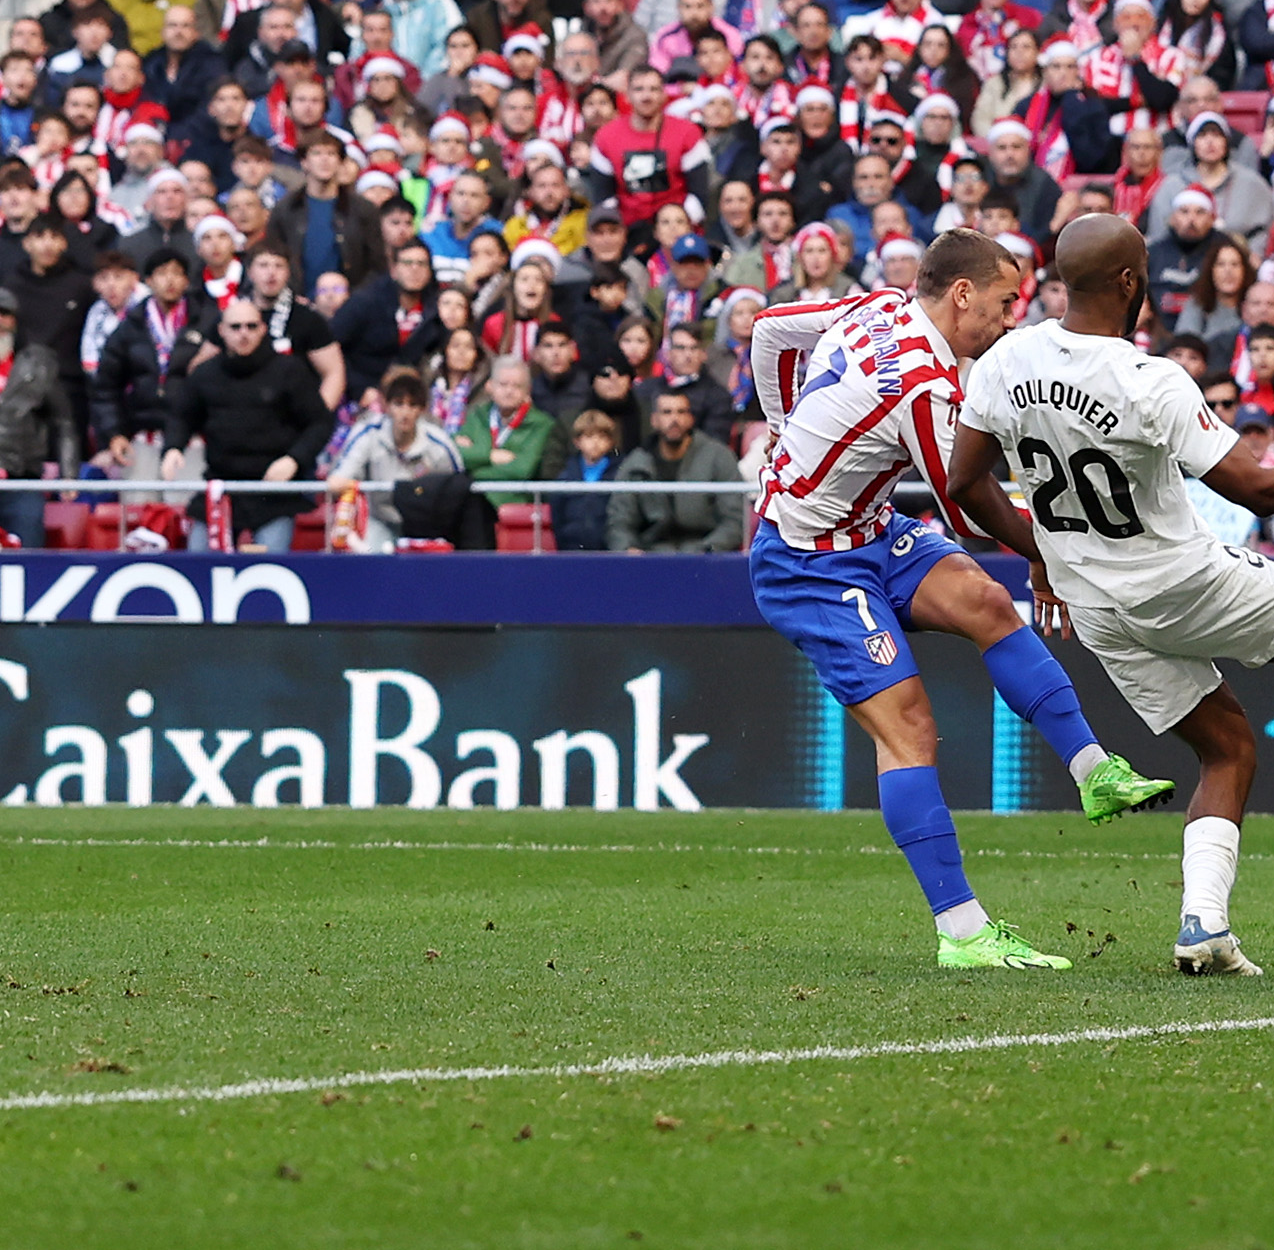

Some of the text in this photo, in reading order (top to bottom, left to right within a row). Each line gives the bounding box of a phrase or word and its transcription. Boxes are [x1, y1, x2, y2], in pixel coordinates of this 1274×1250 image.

[1017, 437, 1144, 540] 20
[841, 587, 878, 631] 7
[0, 658, 709, 811] aixaBank
